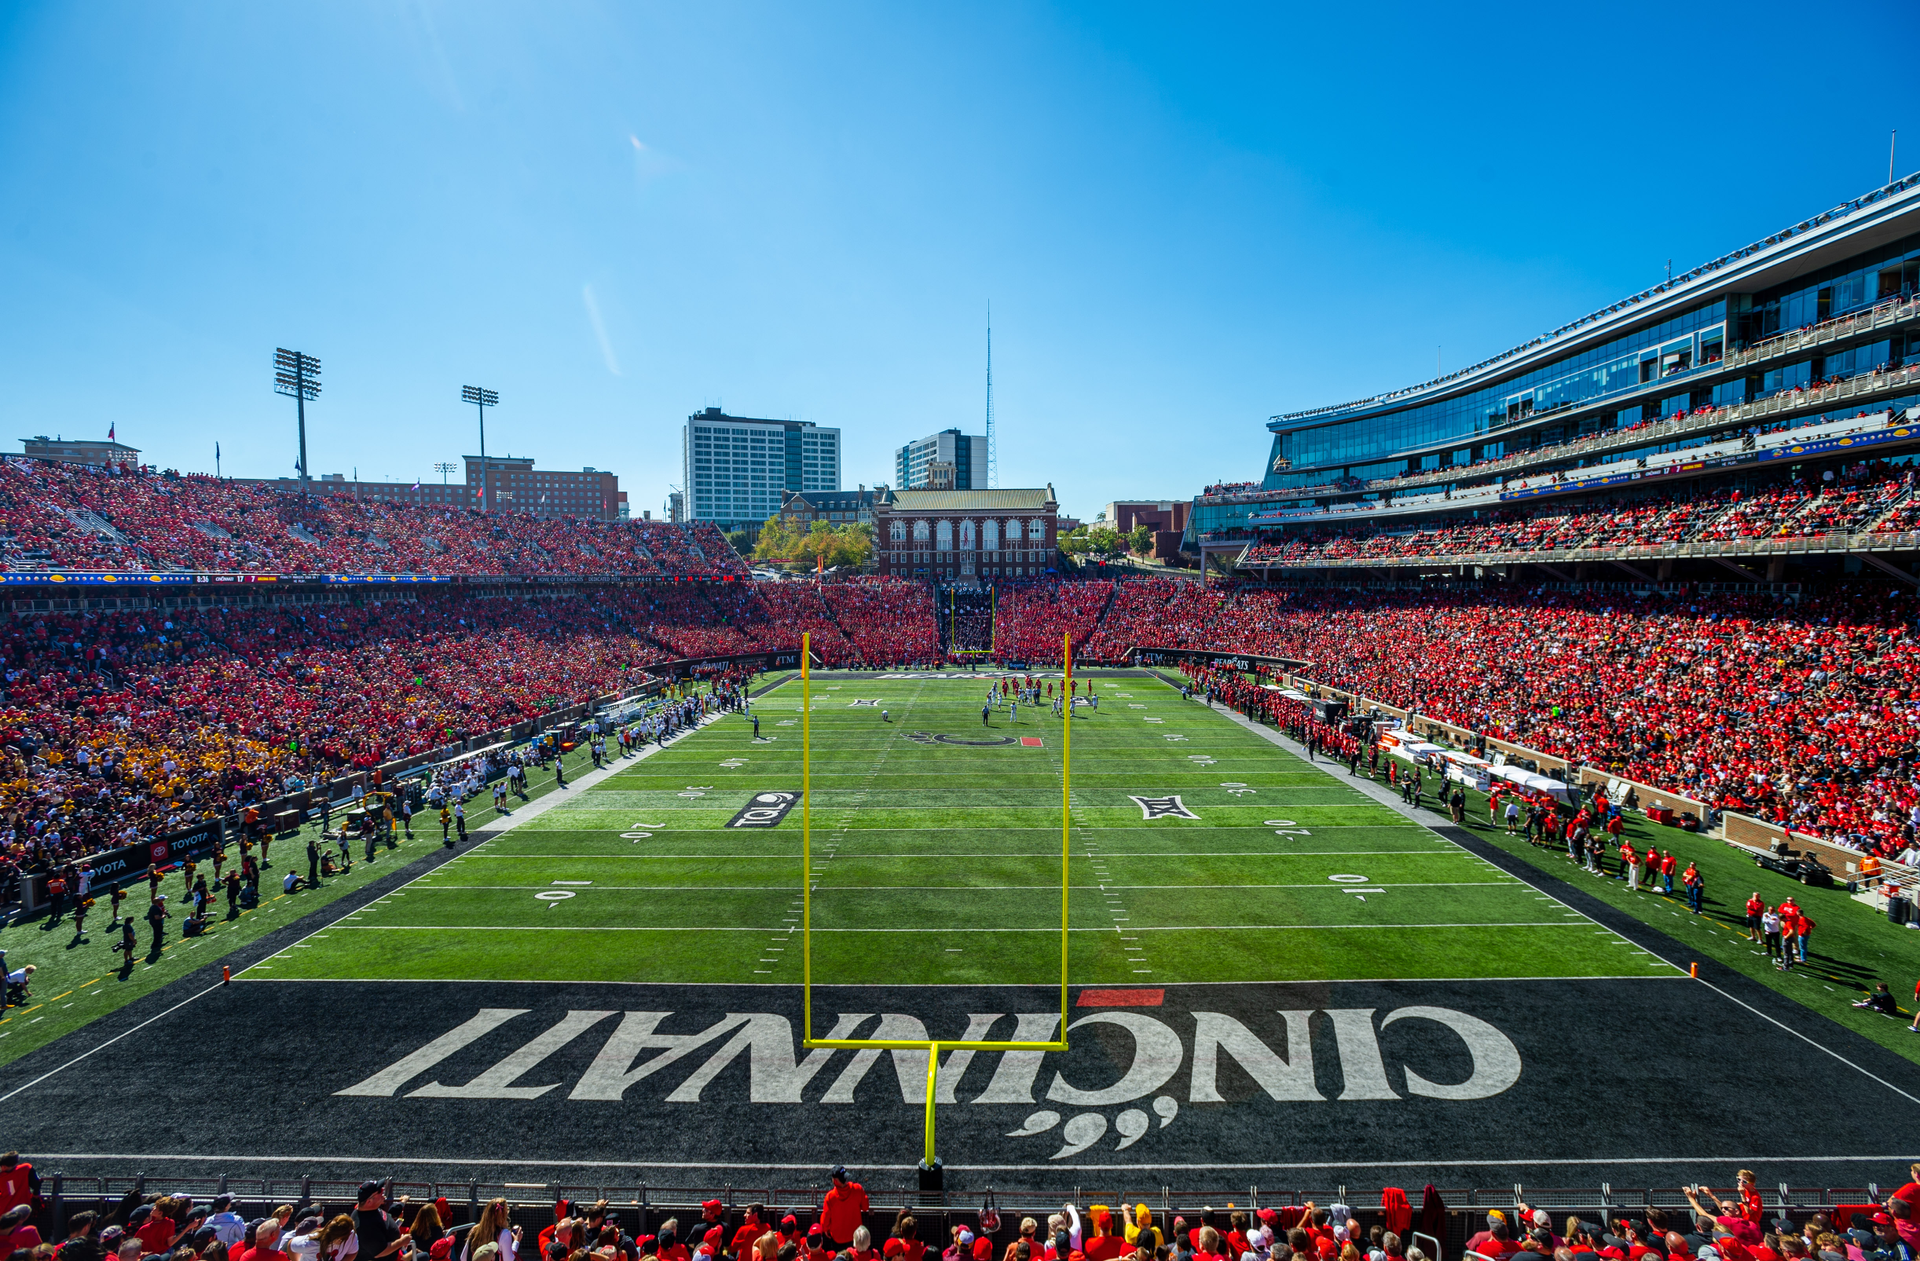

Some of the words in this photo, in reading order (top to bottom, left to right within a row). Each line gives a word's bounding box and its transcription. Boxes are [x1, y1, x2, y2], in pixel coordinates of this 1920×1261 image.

[734, 802, 787, 827] TQL
[620, 822, 666, 838] 20
[1262, 820, 1313, 836] 20
[170, 832, 208, 851] TOYOTA
[94, 860, 126, 876] YOTA
[534, 880, 594, 900] 10
[1327, 874, 1388, 894] 10
[332, 1005, 1522, 1106] CINCINNATI
